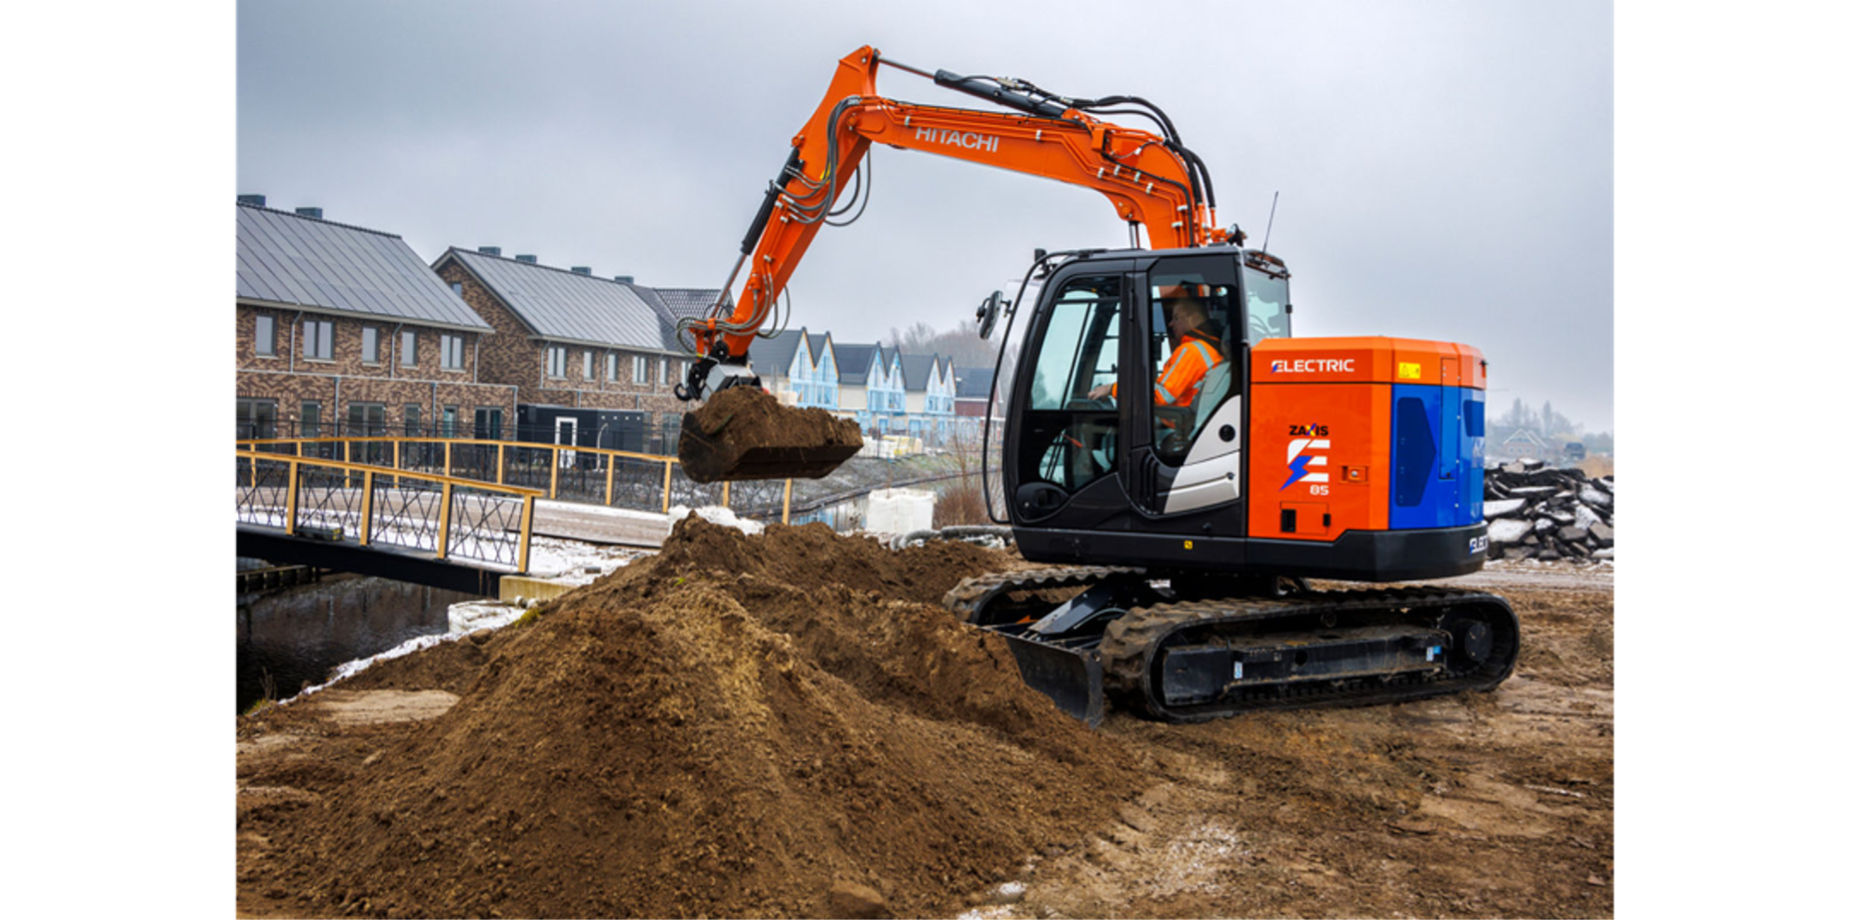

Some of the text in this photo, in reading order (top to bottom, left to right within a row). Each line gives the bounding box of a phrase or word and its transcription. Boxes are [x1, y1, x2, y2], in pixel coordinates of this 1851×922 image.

[915, 126, 999, 153] HITACHI
[1271, 359, 1355, 373] ELECTRIC
[1289, 423, 1329, 437] ZAXIS
[1309, 484, 1329, 496] 85
